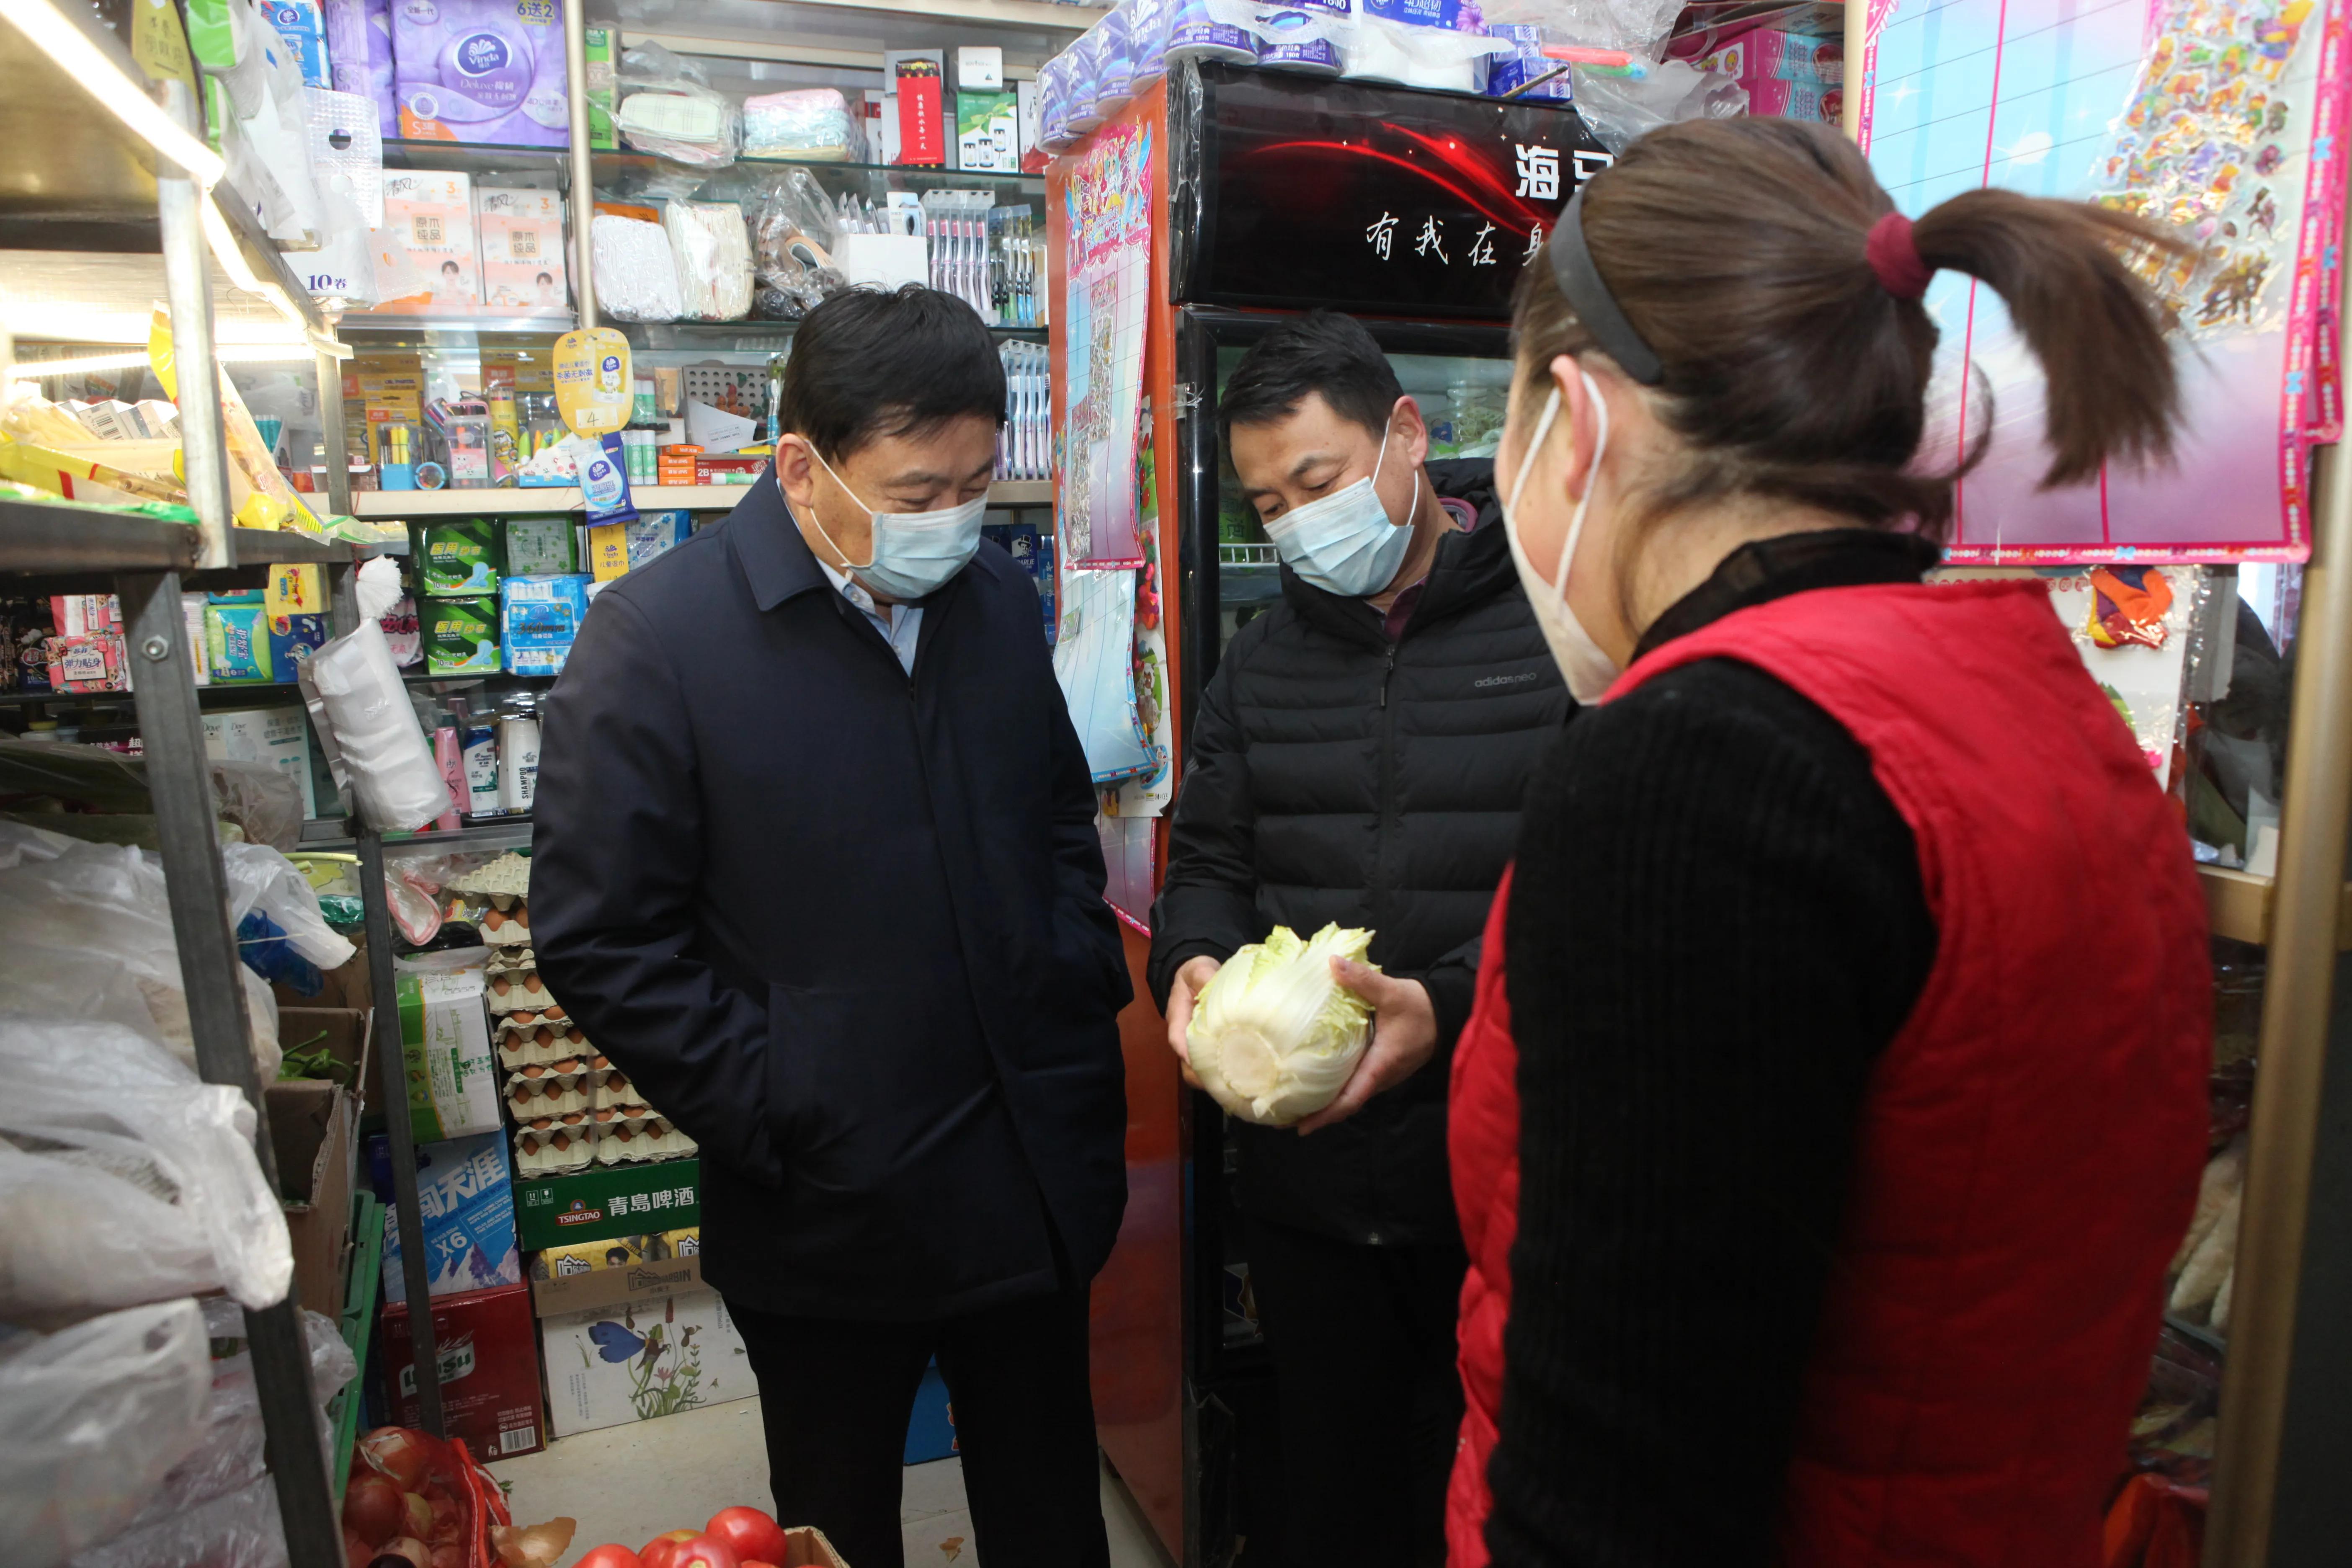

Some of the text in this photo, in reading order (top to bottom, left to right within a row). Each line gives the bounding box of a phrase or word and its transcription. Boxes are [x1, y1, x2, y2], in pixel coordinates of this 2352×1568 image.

[516, 3, 553, 18] 6送2
[468, 52, 500, 65] Vinda
[461, 79, 494, 90] Deluxe
[385, 177, 420, 196] 清风
[484, 193, 517, 212] 清风
[415, 217, 440, 229] 原木
[417, 229, 441, 241] 纯品
[512, 231, 535, 242] 原木
[513, 243, 536, 253] 纯品
[556, 368, 594, 380] 杀菌无刺激
[697, 468, 709, 477] 2B
[517, 622, 566, 635] 360mm
[236, 628, 249, 661] 护舒宝
[64, 658, 102, 669] 弹力贴身
[203, 724, 221, 733] Dove
[231, 723, 247, 731] Dove
[519, 767, 529, 799] SHAMPOO
[608, 1186, 695, 1217] 青岛啤酒
[557, 1211, 601, 1224] TSINGTAO
[435, 1231, 468, 1259] X6
